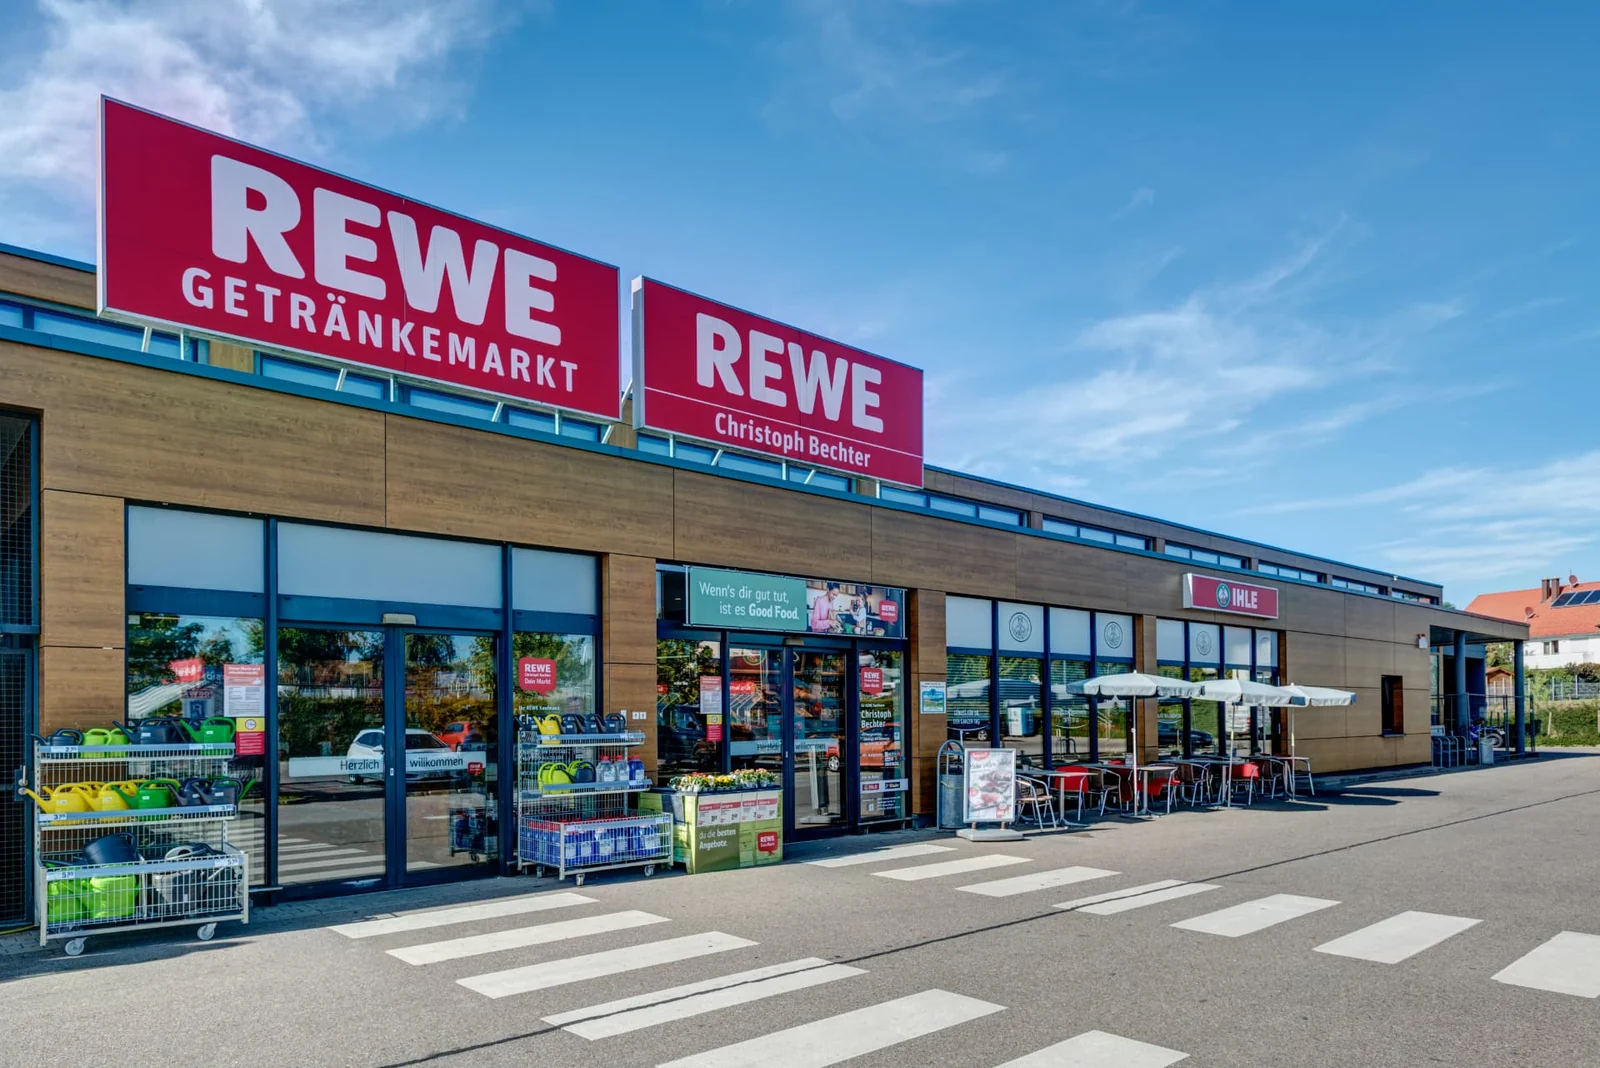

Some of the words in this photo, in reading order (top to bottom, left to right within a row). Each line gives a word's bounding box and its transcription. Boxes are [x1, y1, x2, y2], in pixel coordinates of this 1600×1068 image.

[210, 154, 562, 346] REWE
[181, 267, 578, 393] GETRÄNKEMARKT
[696, 312, 884, 433] REWE
[715, 412, 804, 454] Christoph
[809, 435, 871, 468] Bechter
[699, 581, 736, 598] Wenn's
[739, 585, 753, 599] dir
[755, 590, 771, 604] gut
[773, 590, 790, 605] tut,
[1232, 587, 1258, 609] IHLE
[720, 601, 732, 615] ist
[734, 605, 746, 616] es
[749, 603, 773, 618] Good
[775, 606, 800, 620] Food.
[524, 663, 552, 673] REWE
[863, 671, 880, 679] REWE
[861, 709, 892, 719] Christoph
[861, 720, 886, 728] Bechter
[340, 758, 380, 771] Herzlich
[410, 757, 464, 768] willkommen
[716, 828, 737, 838] besten
[760, 835, 775, 843] REWE
[699, 840, 729, 851] Angebote.
